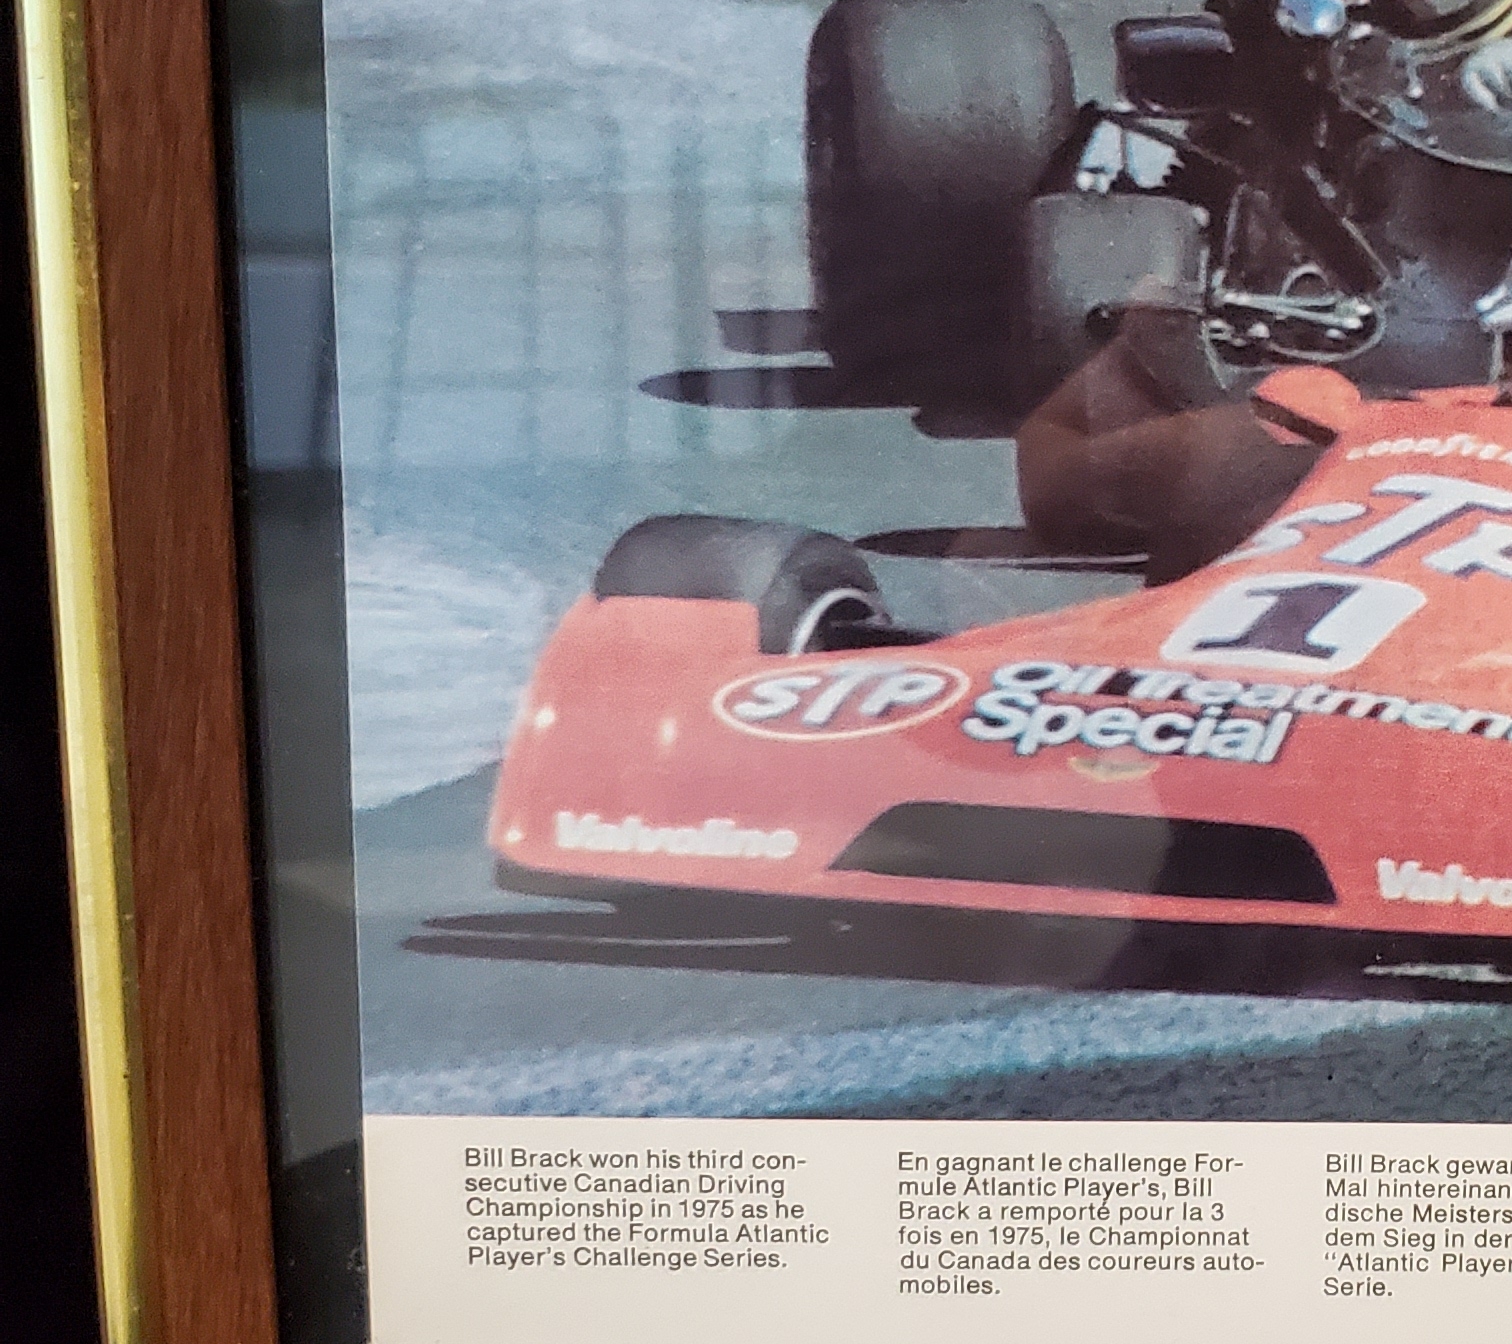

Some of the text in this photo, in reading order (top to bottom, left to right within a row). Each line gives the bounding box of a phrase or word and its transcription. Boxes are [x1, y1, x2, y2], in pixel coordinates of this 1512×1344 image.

[1192, 581, 1362, 659] 1
[991, 660, 1119, 696] Oil
[732, 660, 947, 727] STP
[962, 688, 1295, 764] Special
[555, 810, 799, 860] Valvoline
[464, 1147, 807, 1170] Bill Brack won his third con-
[898, 1151, 1244, 1177] En gagnant le challenge For-
[1326, 1153, 1363, 1174] Bill
[1370, 1154, 1440, 1175] Brack
[464, 1172, 785, 1199] secutive Canadian Driving
[897, 1176, 1212, 1203] mule Atlantic Player's, Bill
[1326, 1177, 1368, 1198] Mal
[466, 1196, 805, 1222] Championship in 1975 as he
[899, 1200, 1225, 1226] Brack a remporté pour la 3
[1325, 1202, 1404, 1223] dische
[467, 1222, 829, 1246] captured the Formula Atlantic
[898, 1225, 1250, 1251] fois en 1975, le Championnat
[1325, 1227, 1375, 1247] dem
[1383, 1227, 1436, 1253] Sieg
[1444, 1228, 1465, 1248] in
[468, 1245, 787, 1272] Player's Challenge Series.
[900, 1249, 1265, 1271] du Canada des coureurs auto-
[899, 1274, 1001, 1295] mobiles.
[1323, 1276, 1393, 1297] Serie.
